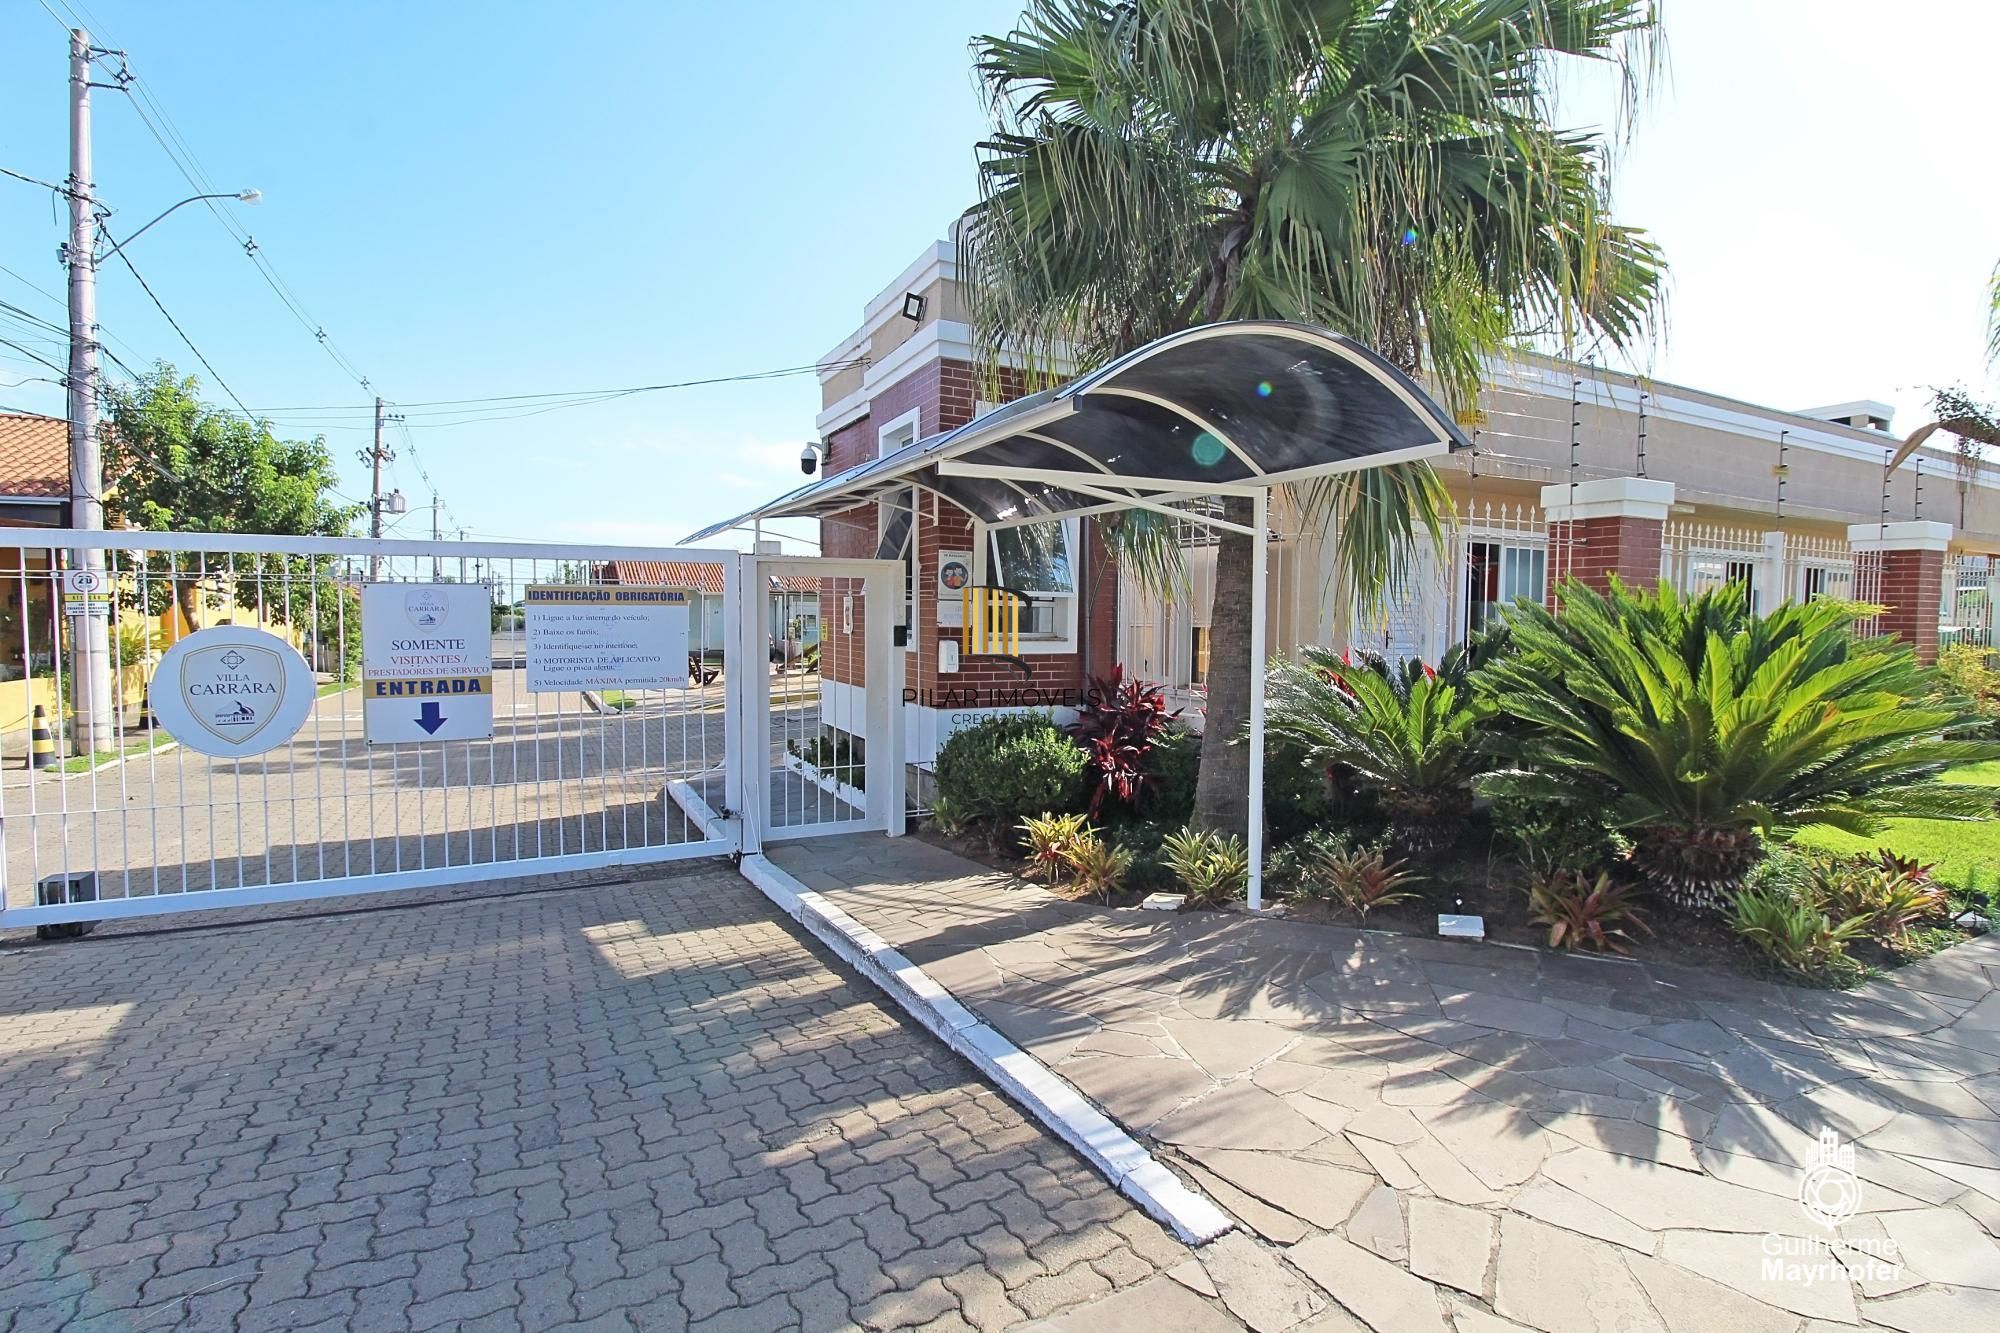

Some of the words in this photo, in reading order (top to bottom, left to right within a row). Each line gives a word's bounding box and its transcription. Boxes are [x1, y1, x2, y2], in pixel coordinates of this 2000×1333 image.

[528, 590, 610, 602] IDENTIFICAÇÃO
[615, 590, 685, 602] OBRIGATÓRIA
[542, 614, 564, 622] Ligue
[391, 639, 466, 651] SOMENTE
[390, 655, 461, 665] VISITANTES
[597, 656, 609, 664] DE
[368, 667, 434, 676] PRESTADORES
[450, 666, 489, 675] SERVIÇO
[543, 665, 565, 673] Ligue
[573, 665, 592, 673] pisca
[216, 674, 250, 682] VILLA
[585, 676, 623, 685] MÁXIMA
[190, 683, 277, 696] CARRARA
[376, 679, 482, 696] ENTRADA
